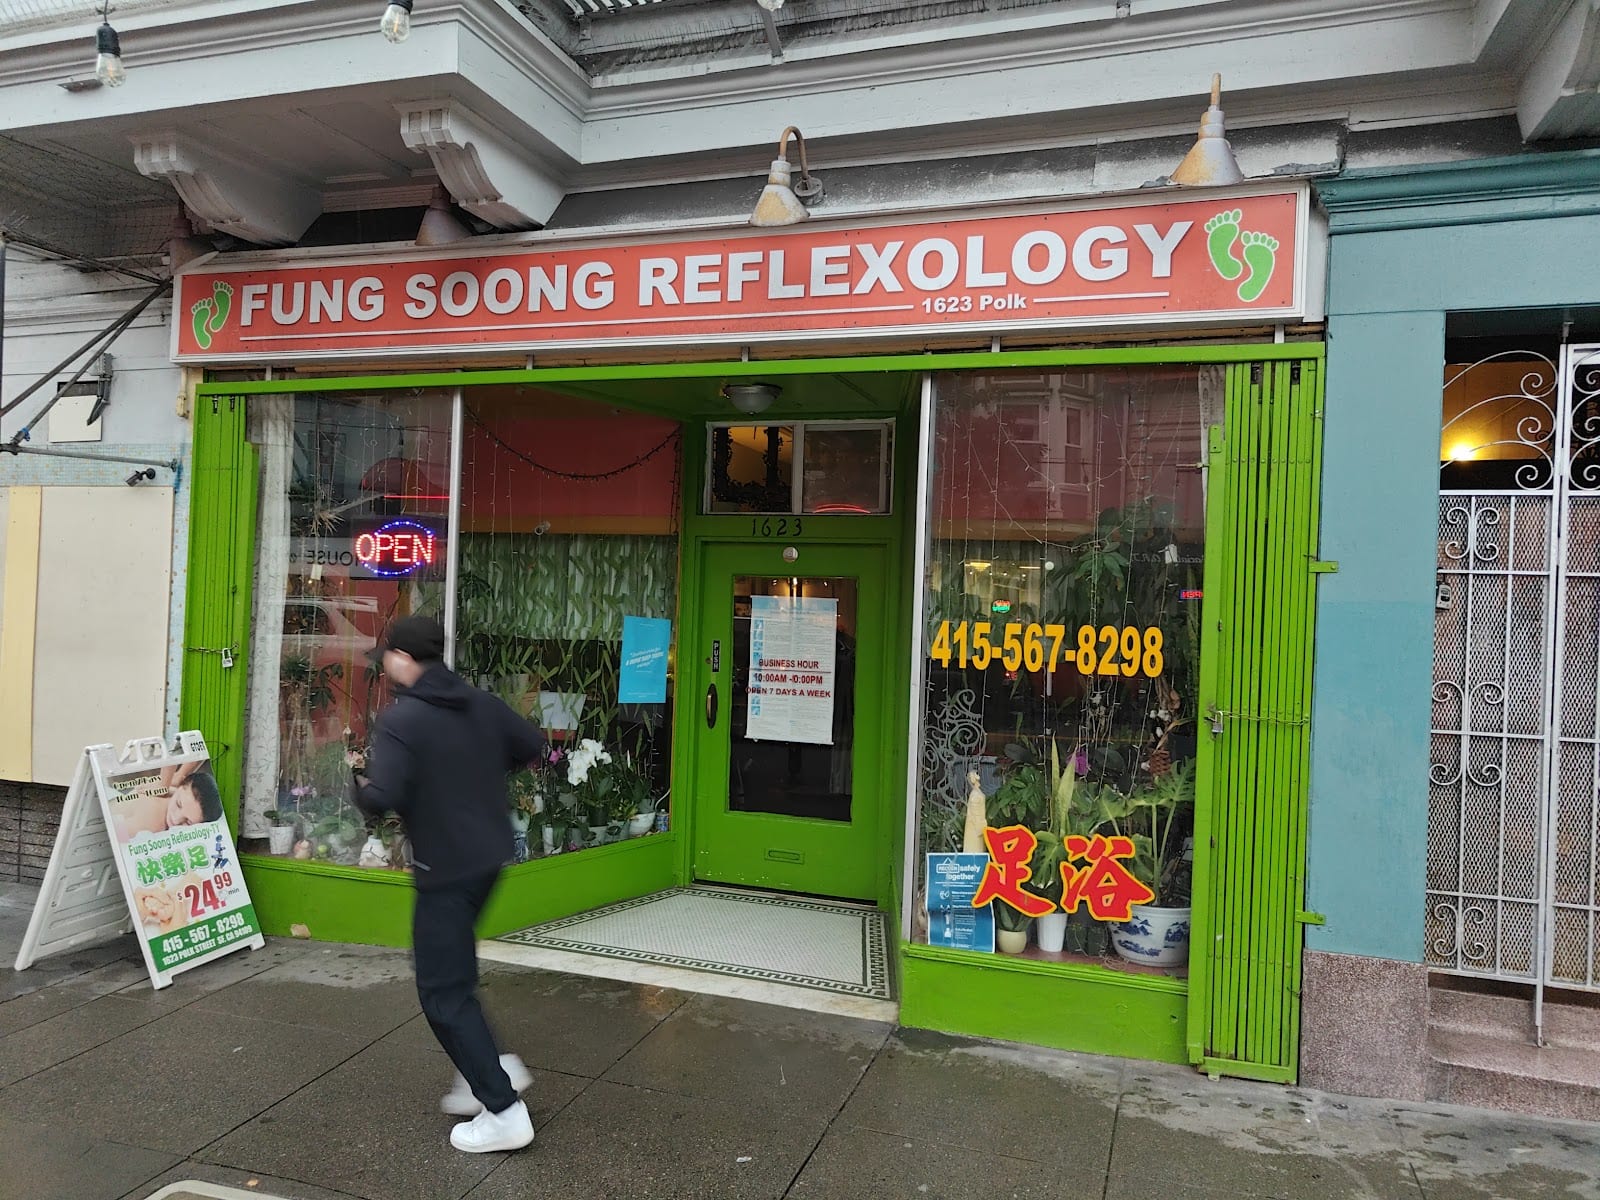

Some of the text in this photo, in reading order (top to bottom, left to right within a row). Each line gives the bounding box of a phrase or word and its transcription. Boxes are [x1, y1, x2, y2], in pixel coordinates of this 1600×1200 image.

[240, 221, 1194, 328] FUNG SOONG REFLEXOLOGY
[921, 292, 1027, 315] 1623 Polk
[751, 518, 803, 537] 1623
[355, 533, 433, 563] OPEN
[931, 620, 1164, 678] 415-567-8298
[758, 658, 819, 669] BUSINESS HOUR
[745, 686, 767, 694] OPEN
[775, 688, 799, 696] DAYS
[799, 689, 805, 697] A
[807, 689, 831, 698] WEEK
[128, 844, 148, 856] Fung
[147, 839, 171, 850] Soong
[972, 824, 1155, 922] 足浴
[178, 947, 195, 960] POLK
[194, 938, 216, 954] STREET
